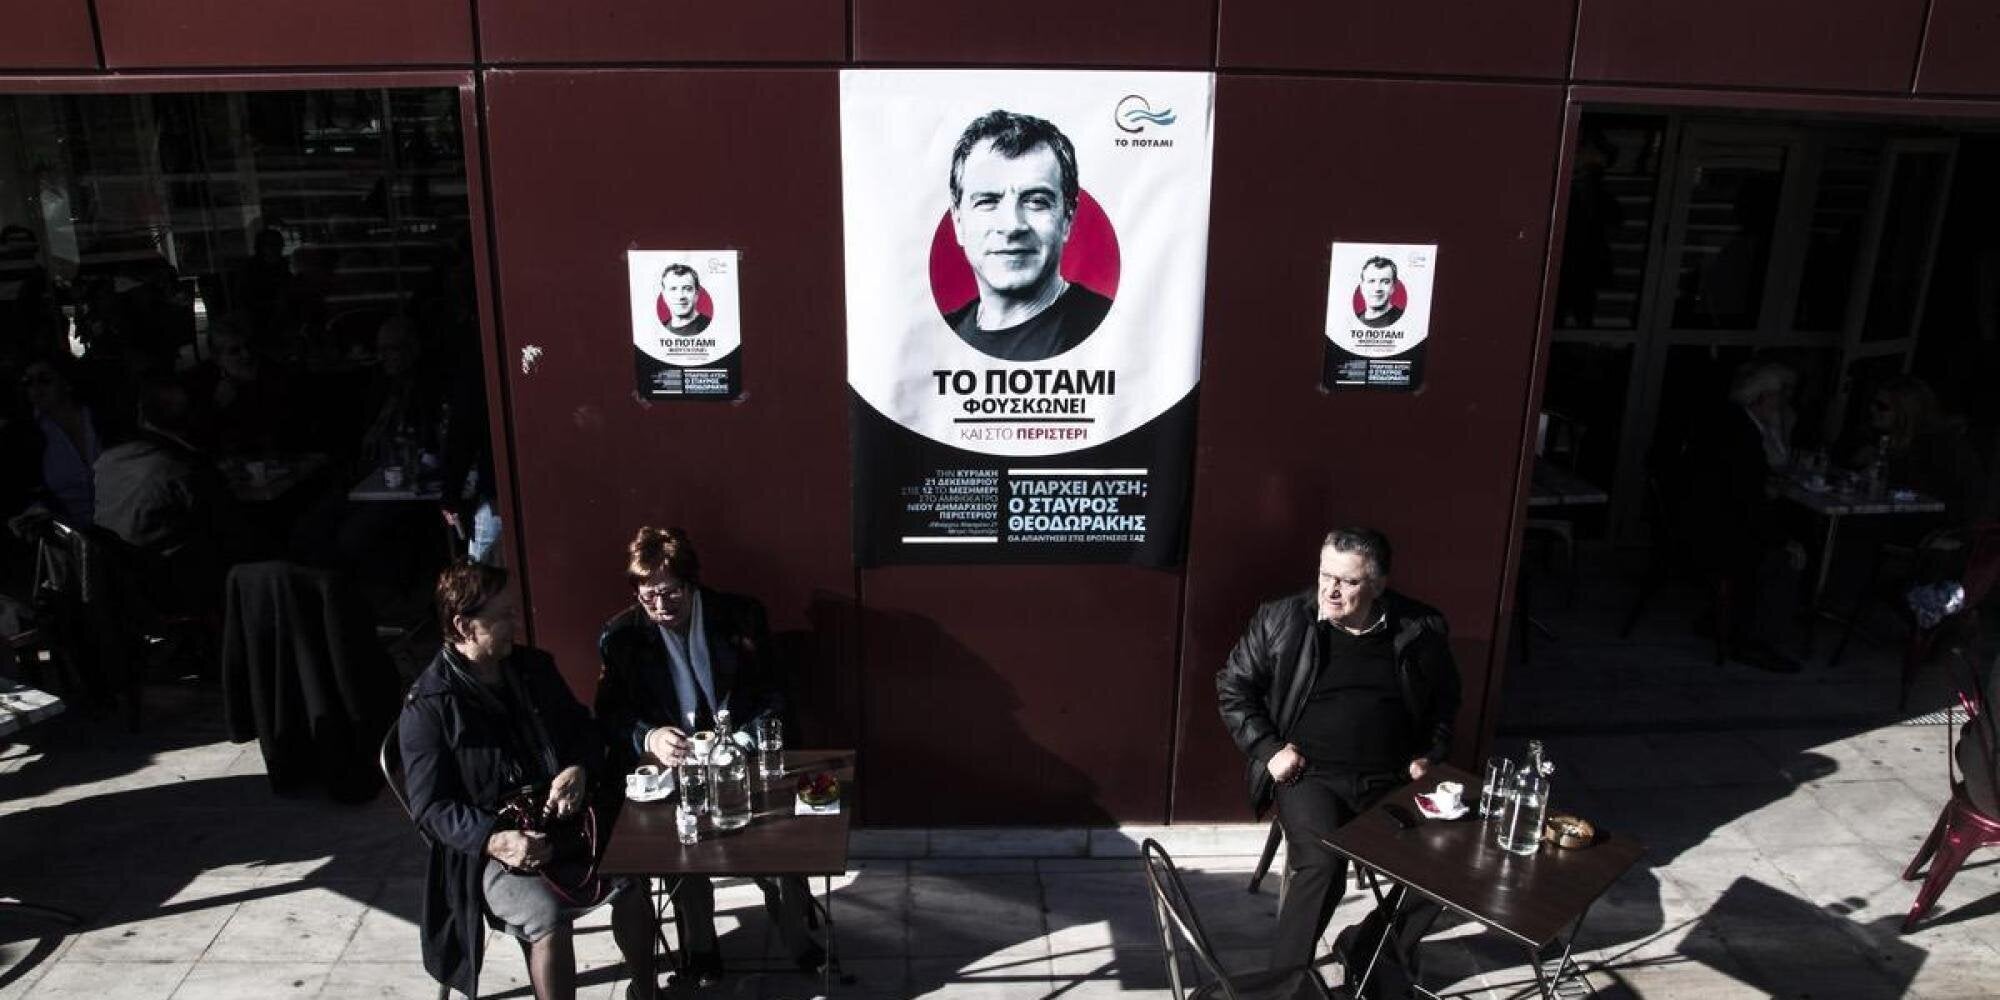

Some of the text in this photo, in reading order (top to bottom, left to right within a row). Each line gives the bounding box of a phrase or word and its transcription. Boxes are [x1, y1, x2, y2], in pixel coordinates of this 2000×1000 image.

[1115, 139, 1173, 147] ΤΟ ΠΟΤΑΜΙ
[1350, 330, 1404, 339] ΤΟ ΠΟΤΑΜΙ
[660, 339, 716, 347] ΤΟ ΠΟΤΑΜΙ
[933, 369, 1116, 396] ΤΟ ΠΟΤΑΜΙ
[963, 398, 1086, 415] ΦΟΥΣΚΩΝΕΙ
[960, 428, 1088, 441] ΚΑΙ ΣΤΟ ΠΕΡΙΣΤΕΡΙ
[938, 478, 999, 486] ΔΕΚΕΜΒΡΙΟΥ
[1008, 480, 1148, 498] ΥΠΑΡΧΕΙ ΛΥΣΗ;
[1009, 498, 1119, 513] Ο ΣΤΑΥΡΟΣ
[1009, 515, 1146, 531] ΘΕΟΔΩΡΑΚΗΣ
